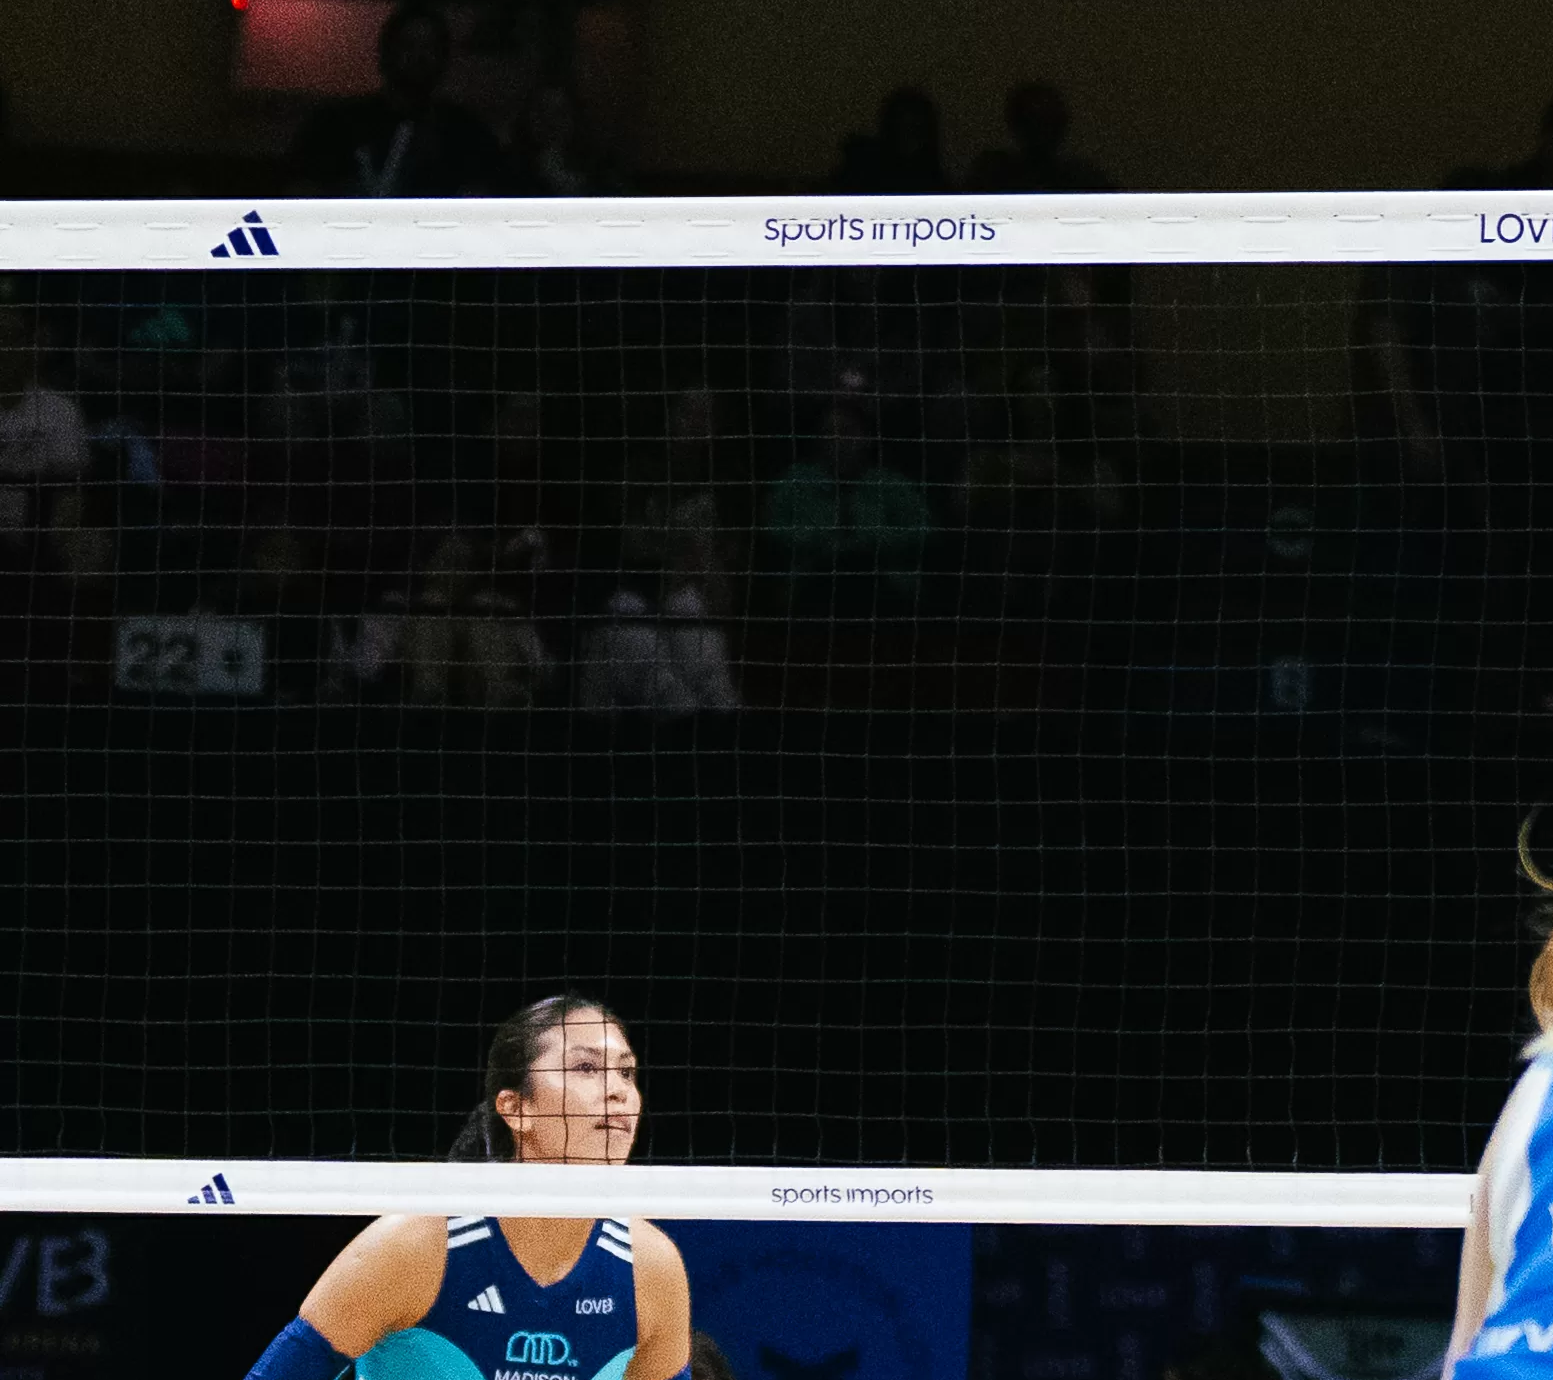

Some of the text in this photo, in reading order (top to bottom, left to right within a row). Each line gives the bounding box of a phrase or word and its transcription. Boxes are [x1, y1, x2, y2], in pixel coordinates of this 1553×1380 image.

[764, 212, 997, 248] sports imports
[771, 1185, 934, 1207] sports imports
[575, 1297, 615, 1316] LOVB
